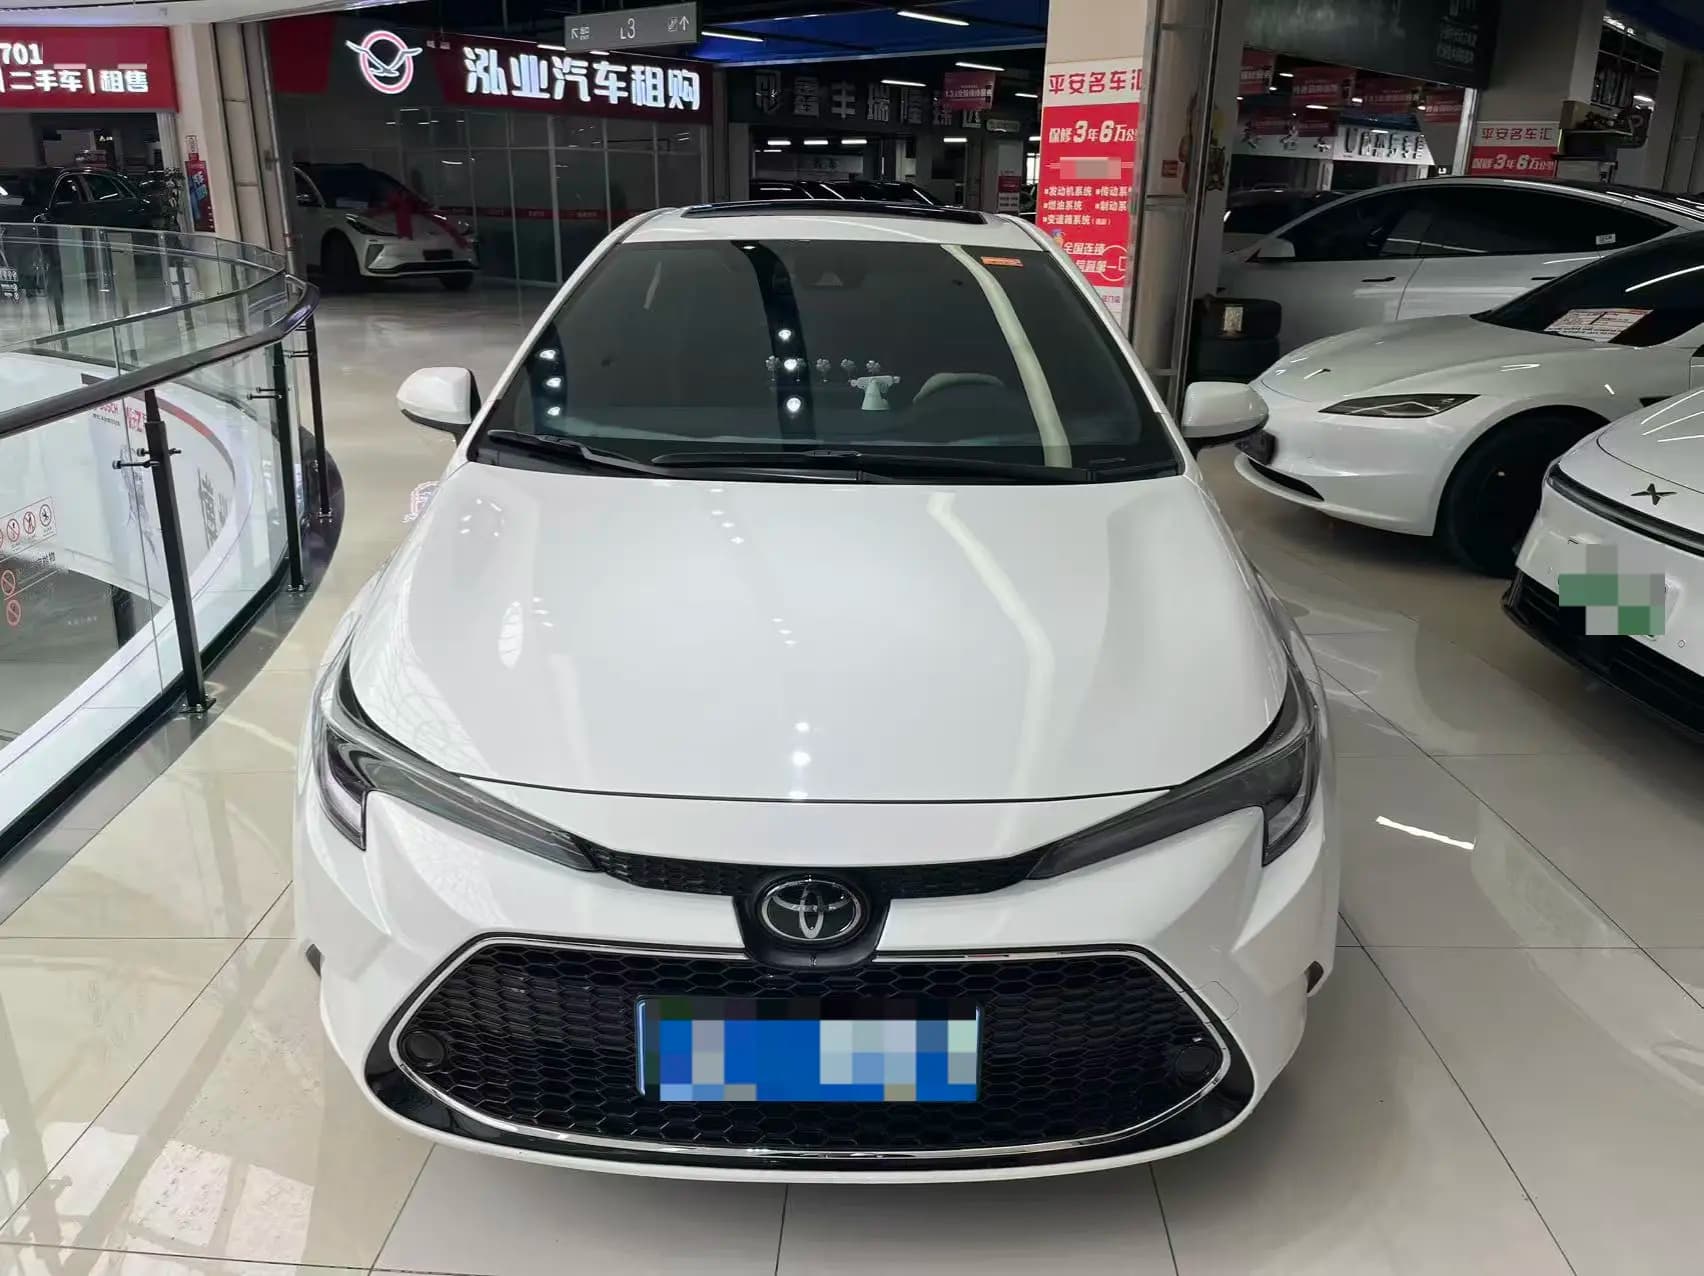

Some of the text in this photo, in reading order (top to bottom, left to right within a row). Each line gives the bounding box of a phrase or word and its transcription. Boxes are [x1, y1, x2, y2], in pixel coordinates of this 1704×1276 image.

[619, 18, 637, 40] L3
[463, 46, 701, 111] 泓业汽车租购
[1048, 120, 1138, 144] 保修3年6万公
[1481, 127, 1553, 141] 平安名车汇
